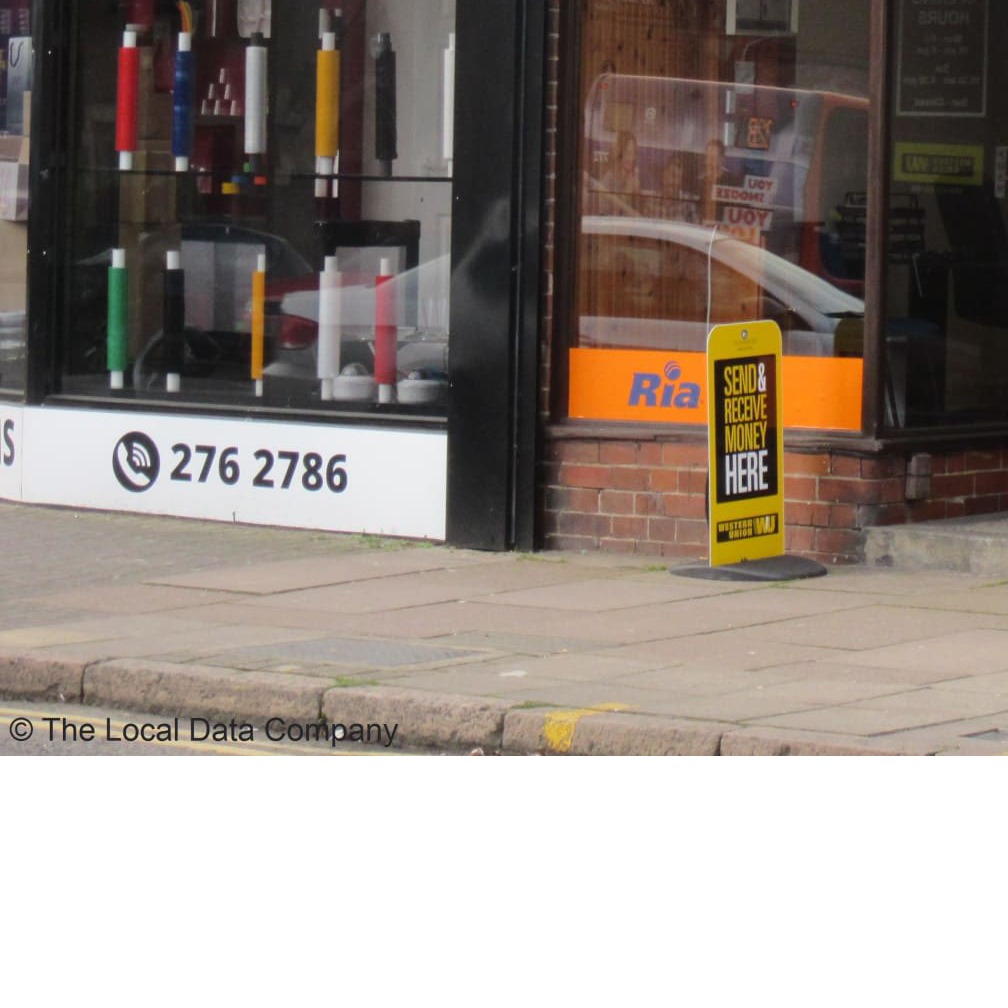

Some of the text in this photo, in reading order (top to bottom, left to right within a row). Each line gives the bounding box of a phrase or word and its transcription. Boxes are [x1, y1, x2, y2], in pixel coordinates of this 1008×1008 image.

[628, 361, 702, 409] Ria
[724, 364, 757, 397] SEND
[724, 394, 768, 425] RECEIVE
[725, 421, 768, 453] MONEY
[170, 443, 348, 493] 276 2786
[726, 449, 769, 496] HERE
[718, 520, 753, 533] WESTERN
